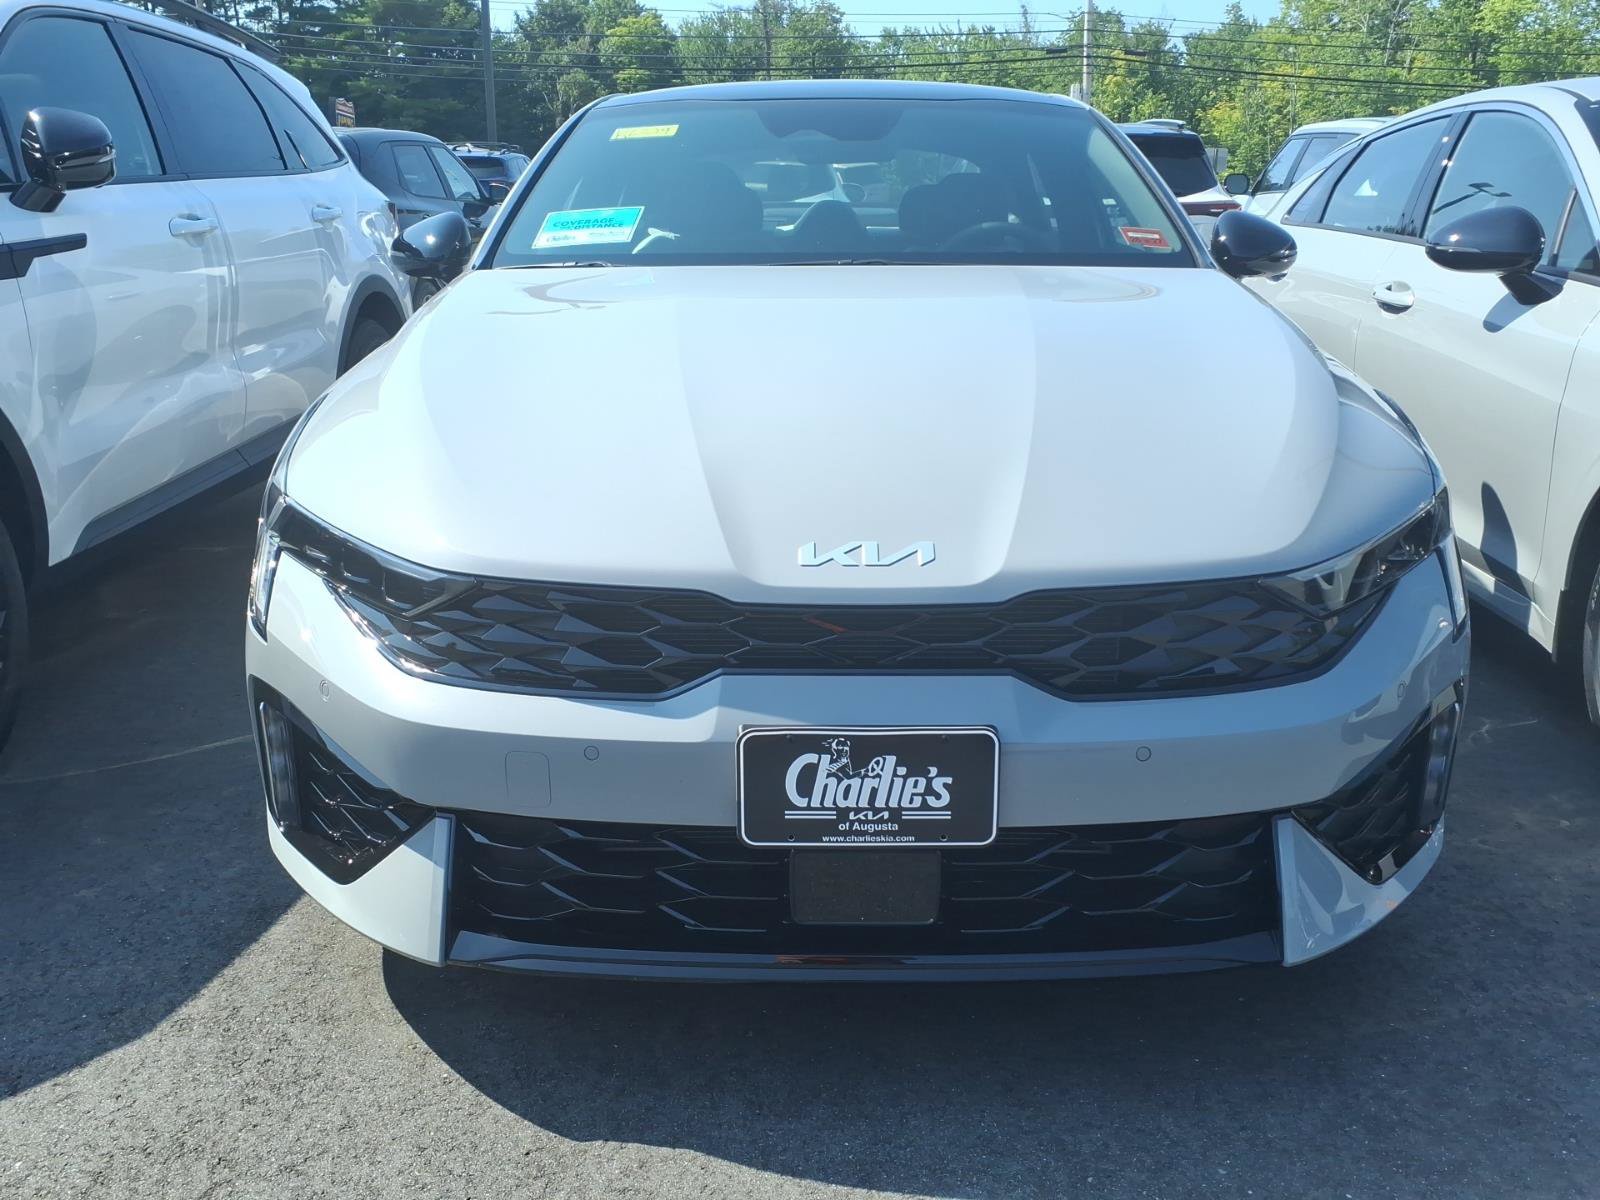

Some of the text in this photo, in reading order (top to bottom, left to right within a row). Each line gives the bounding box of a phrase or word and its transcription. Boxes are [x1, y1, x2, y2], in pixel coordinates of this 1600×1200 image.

[553, 217, 615, 227] COVERAGE
[798, 541, 936, 567] KIA
[785, 753, 953, 808] Charlie's
[849, 811, 889, 820] KIA
[838, 822, 899, 833] of Augusta
[822, 834, 915, 842] www.charlieskia.com
